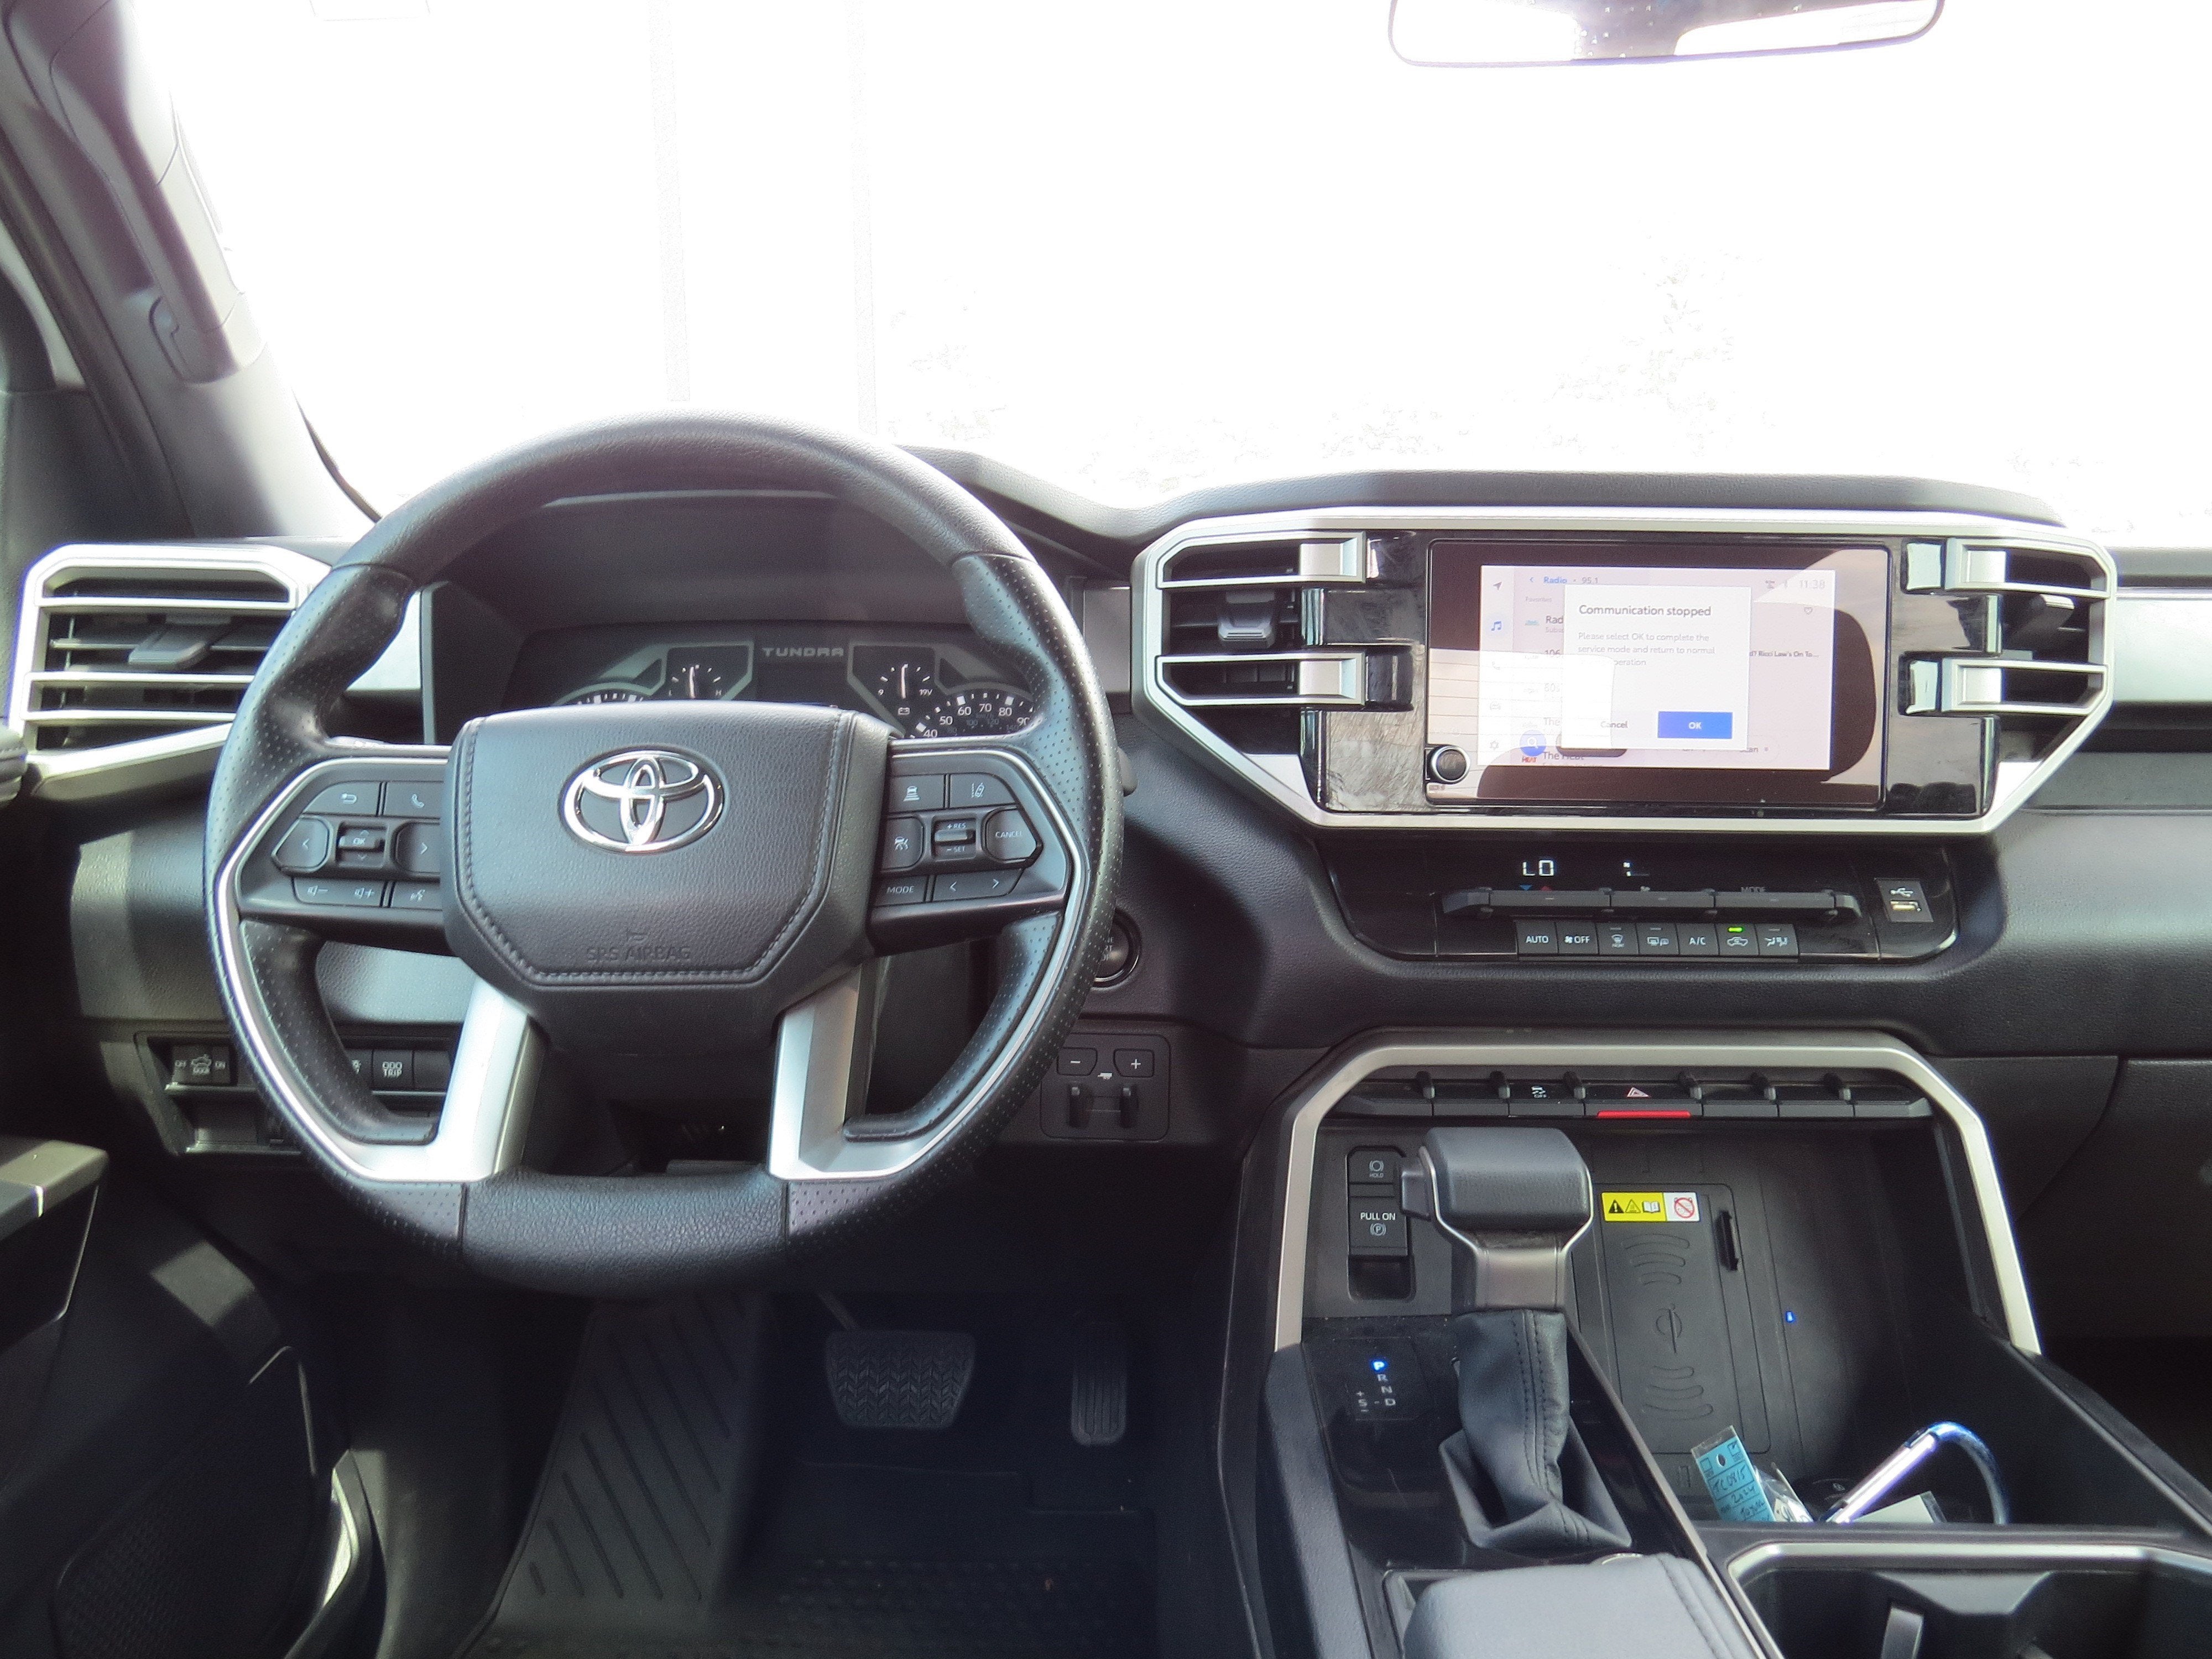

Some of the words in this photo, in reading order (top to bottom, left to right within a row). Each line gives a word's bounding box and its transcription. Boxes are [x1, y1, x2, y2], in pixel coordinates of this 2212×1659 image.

[1543, 576, 1567, 584] Radio
[1579, 604, 1664, 616] Communication
[1667, 606, 1712, 618] stopped
[1578, 632, 1604, 640] Please
[1606, 632, 1629, 640] select
[1656, 633, 1693, 643] complete
[1695, 633, 1709, 641] the
[761, 648, 844, 657] TUNDRA
[1607, 645, 1631, 653] mode
[1687, 646, 1715, 654] normal
[957, 706, 972, 716] 60
[979, 703, 992, 713] 70
[999, 707, 1013, 717] 80
[939, 716, 953, 726] 50
[1688, 722, 1702, 730] OK
[922, 729, 938, 738] 40
[1543, 751, 1559, 760] The
[1522, 860, 1554, 877] LO
[1525, 935, 1549, 944] AUTO
[1574, 935, 1590, 943] OFF
[1689, 937, 1707, 946] A/C
[382, 1061, 403, 1070] ODO
[384, 1069, 403, 1078] TRIP
[1360, 1212, 1381, 1221] PULL
[1382, 1212, 1396, 1221] ON
[1373, 1361, 1385, 1371] P
[1381, 1385, 1392, 1394] N
